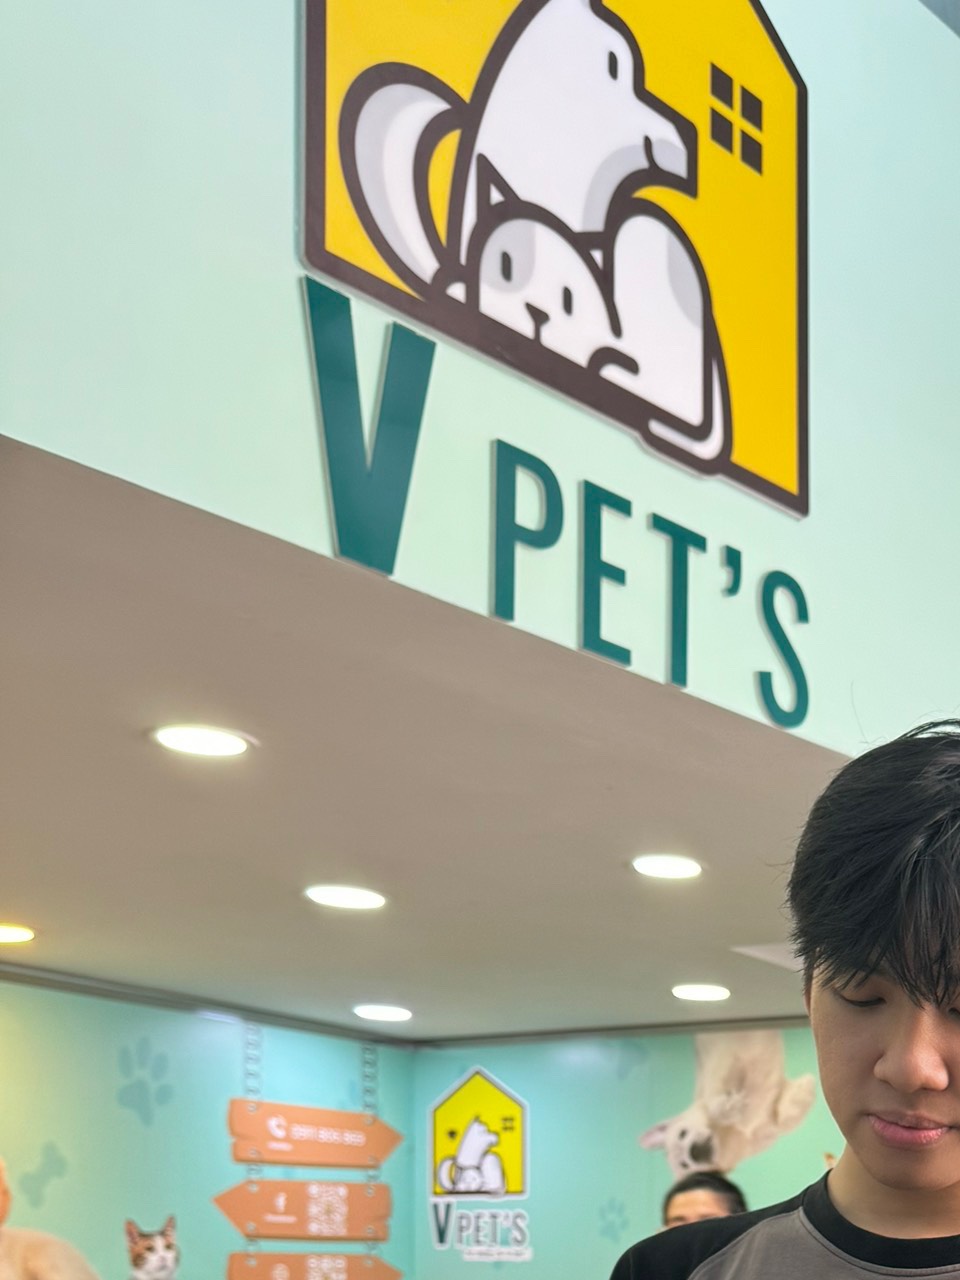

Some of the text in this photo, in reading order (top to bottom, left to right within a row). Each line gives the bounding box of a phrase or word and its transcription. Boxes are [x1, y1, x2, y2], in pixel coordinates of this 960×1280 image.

[304, 275, 809, 730] V PET'S
[432, 1202, 452, 1245] V
